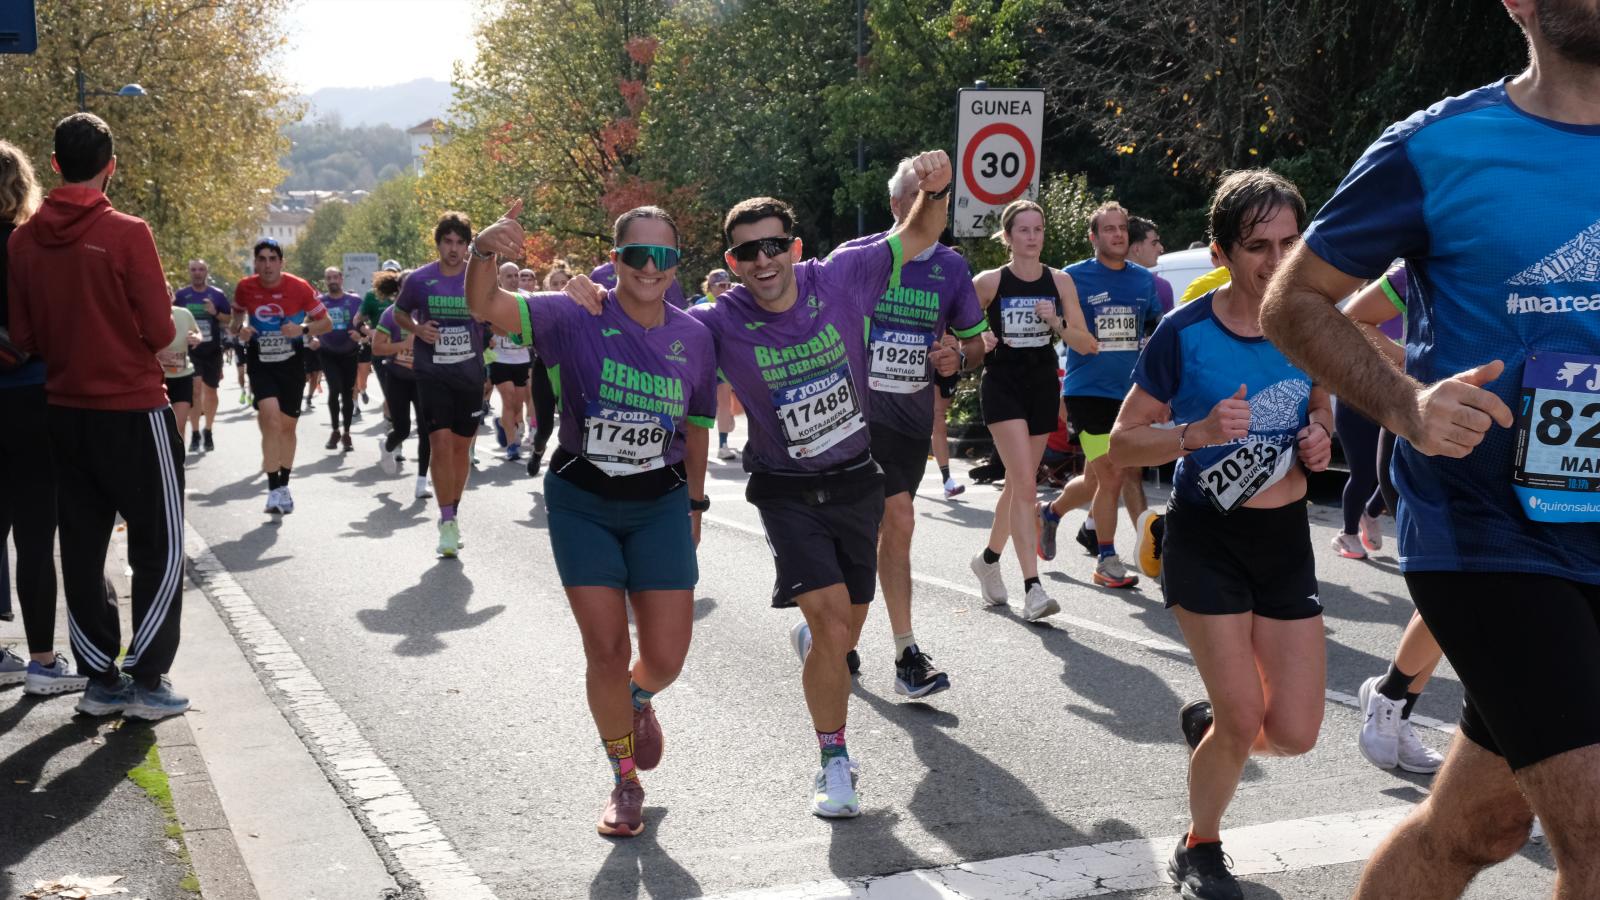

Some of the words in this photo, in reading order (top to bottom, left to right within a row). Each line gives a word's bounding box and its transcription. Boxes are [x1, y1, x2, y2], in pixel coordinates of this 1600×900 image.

[971, 100, 1032, 115] GUNEA
[981, 152, 1020, 178] 30
[880, 287, 940, 309] EHOBIA
[1006, 311, 1048, 325] 1753
[1099, 317, 1135, 330] 28108
[892, 332, 925, 344] Joma
[762, 366, 788, 382] SAN
[788, 341, 847, 376] SEBASTIÁN
[875, 346, 926, 366] 19265
[601, 357, 684, 401] BEHOBIA
[798, 372, 840, 400] Joma
[599, 383, 624, 403] SAN
[625, 392, 685, 417] SEBASTIÁN
[786, 385, 849, 428] 17488
[1522, 395, 1532, 416] 7
[593, 422, 664, 447] 17486
[1536, 398, 1600, 448] 82
[617, 448, 637, 457] JANI
